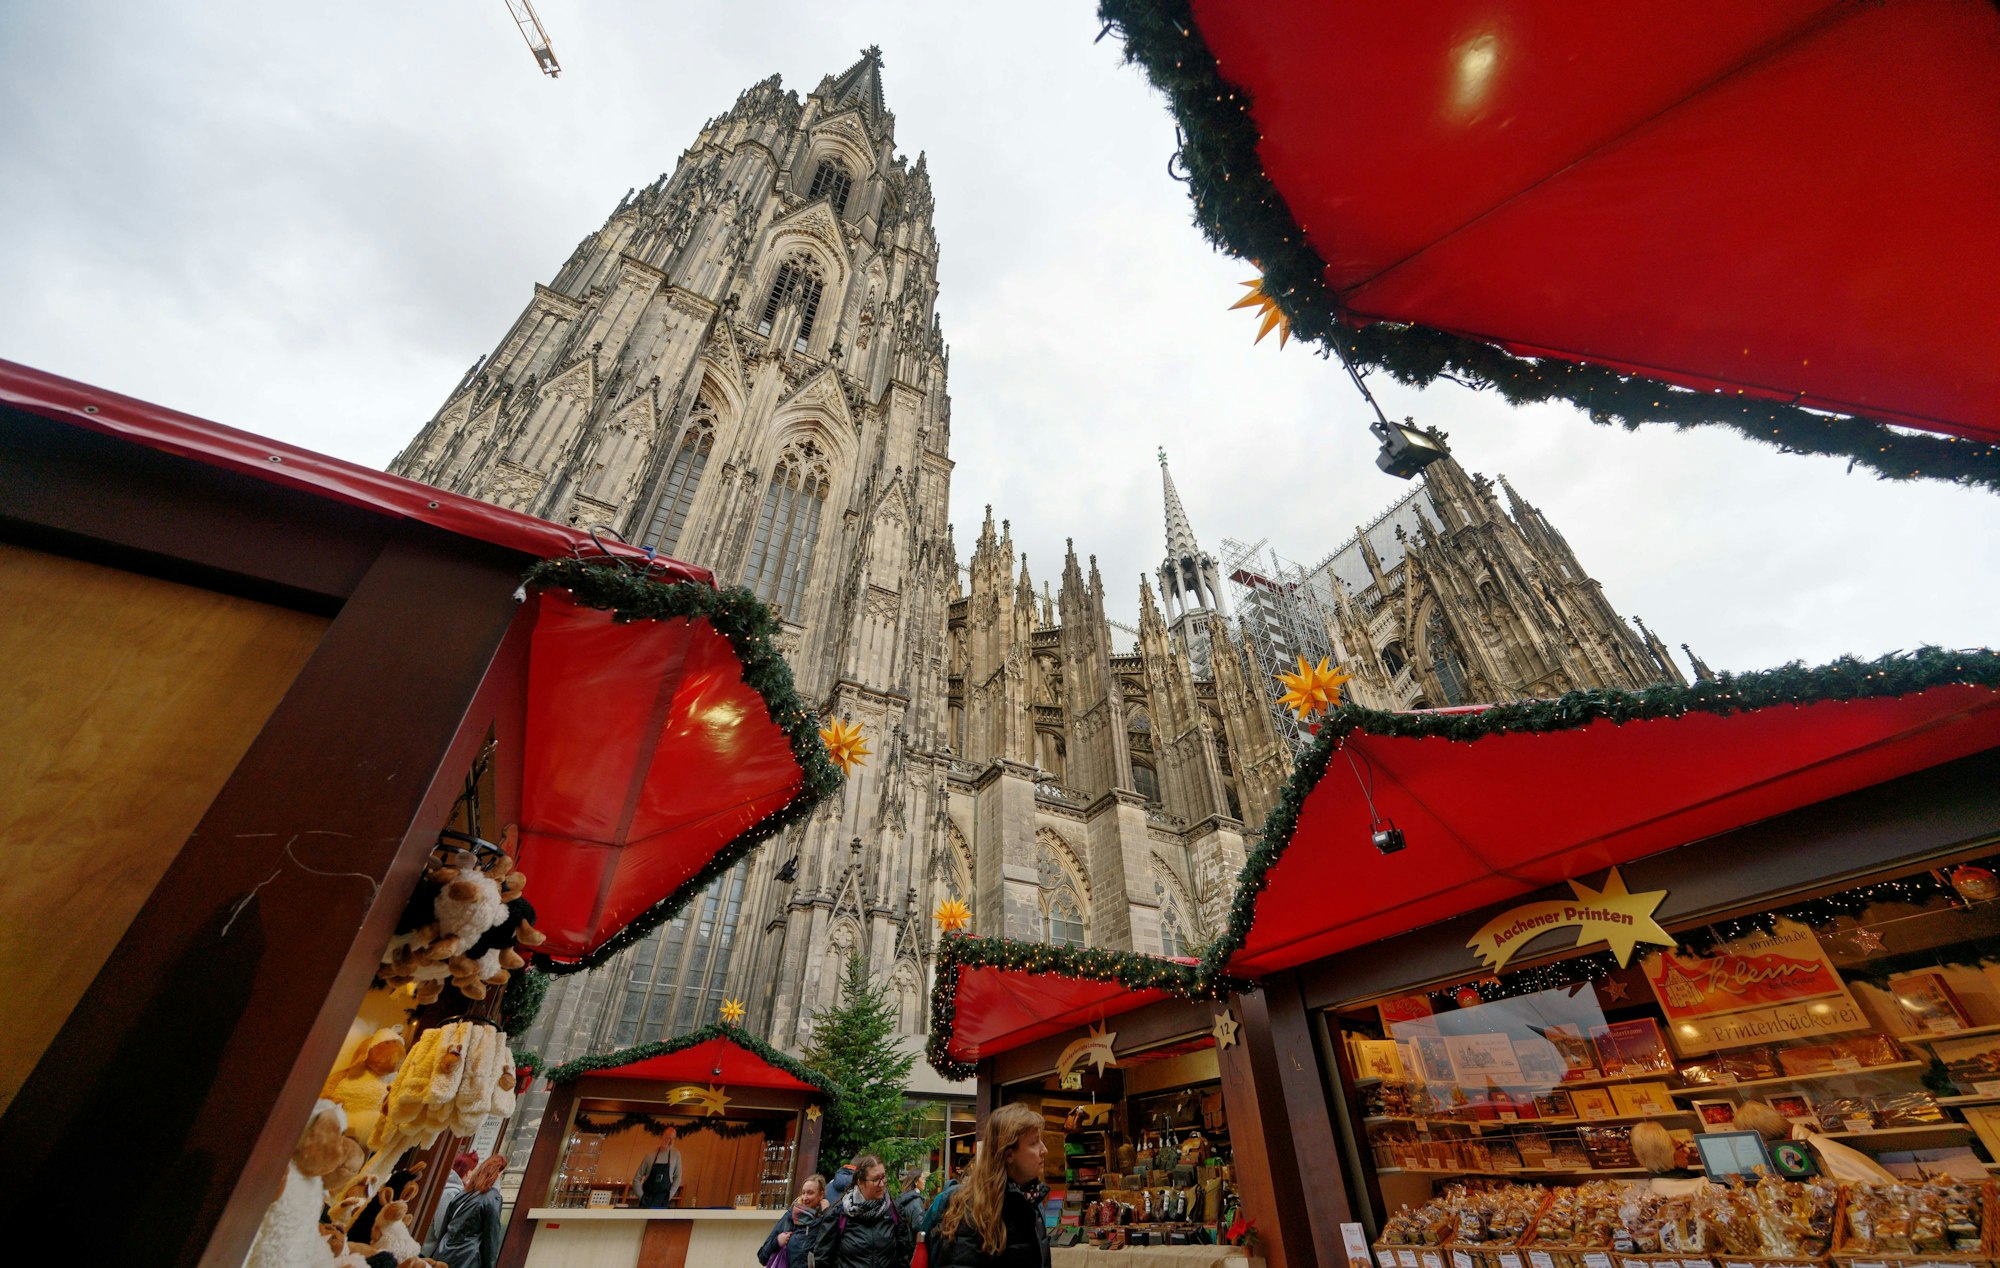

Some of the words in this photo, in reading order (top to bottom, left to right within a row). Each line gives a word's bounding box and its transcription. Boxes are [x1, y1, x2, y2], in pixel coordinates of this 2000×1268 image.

[1493, 911, 1560, 948] Aachener
[1564, 907, 1633, 926] Printen
[1749, 930, 1808, 953] printen.de
[1695, 956, 1821, 995] klein
[1220, 1022, 1230, 1036] 12
[1712, 1002, 1858, 1042] Printenbäckerei
